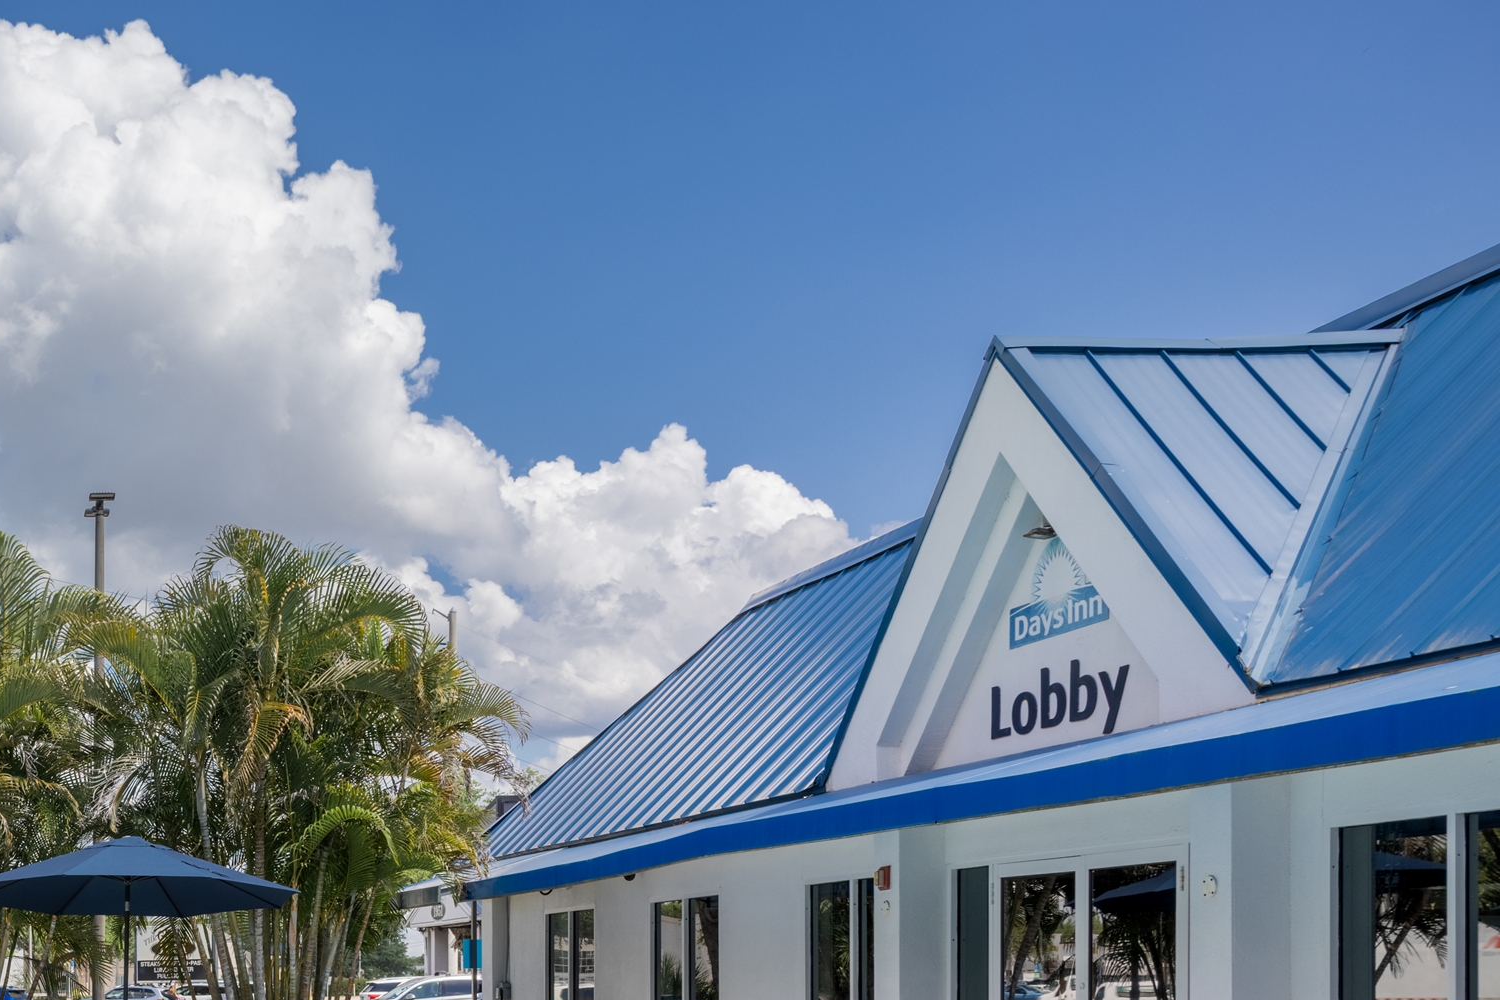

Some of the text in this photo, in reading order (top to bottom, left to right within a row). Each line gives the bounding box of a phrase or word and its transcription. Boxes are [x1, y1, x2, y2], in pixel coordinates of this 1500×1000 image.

[1014, 594, 1103, 641] Days Inn
[990, 659, 1130, 740] Lobby
